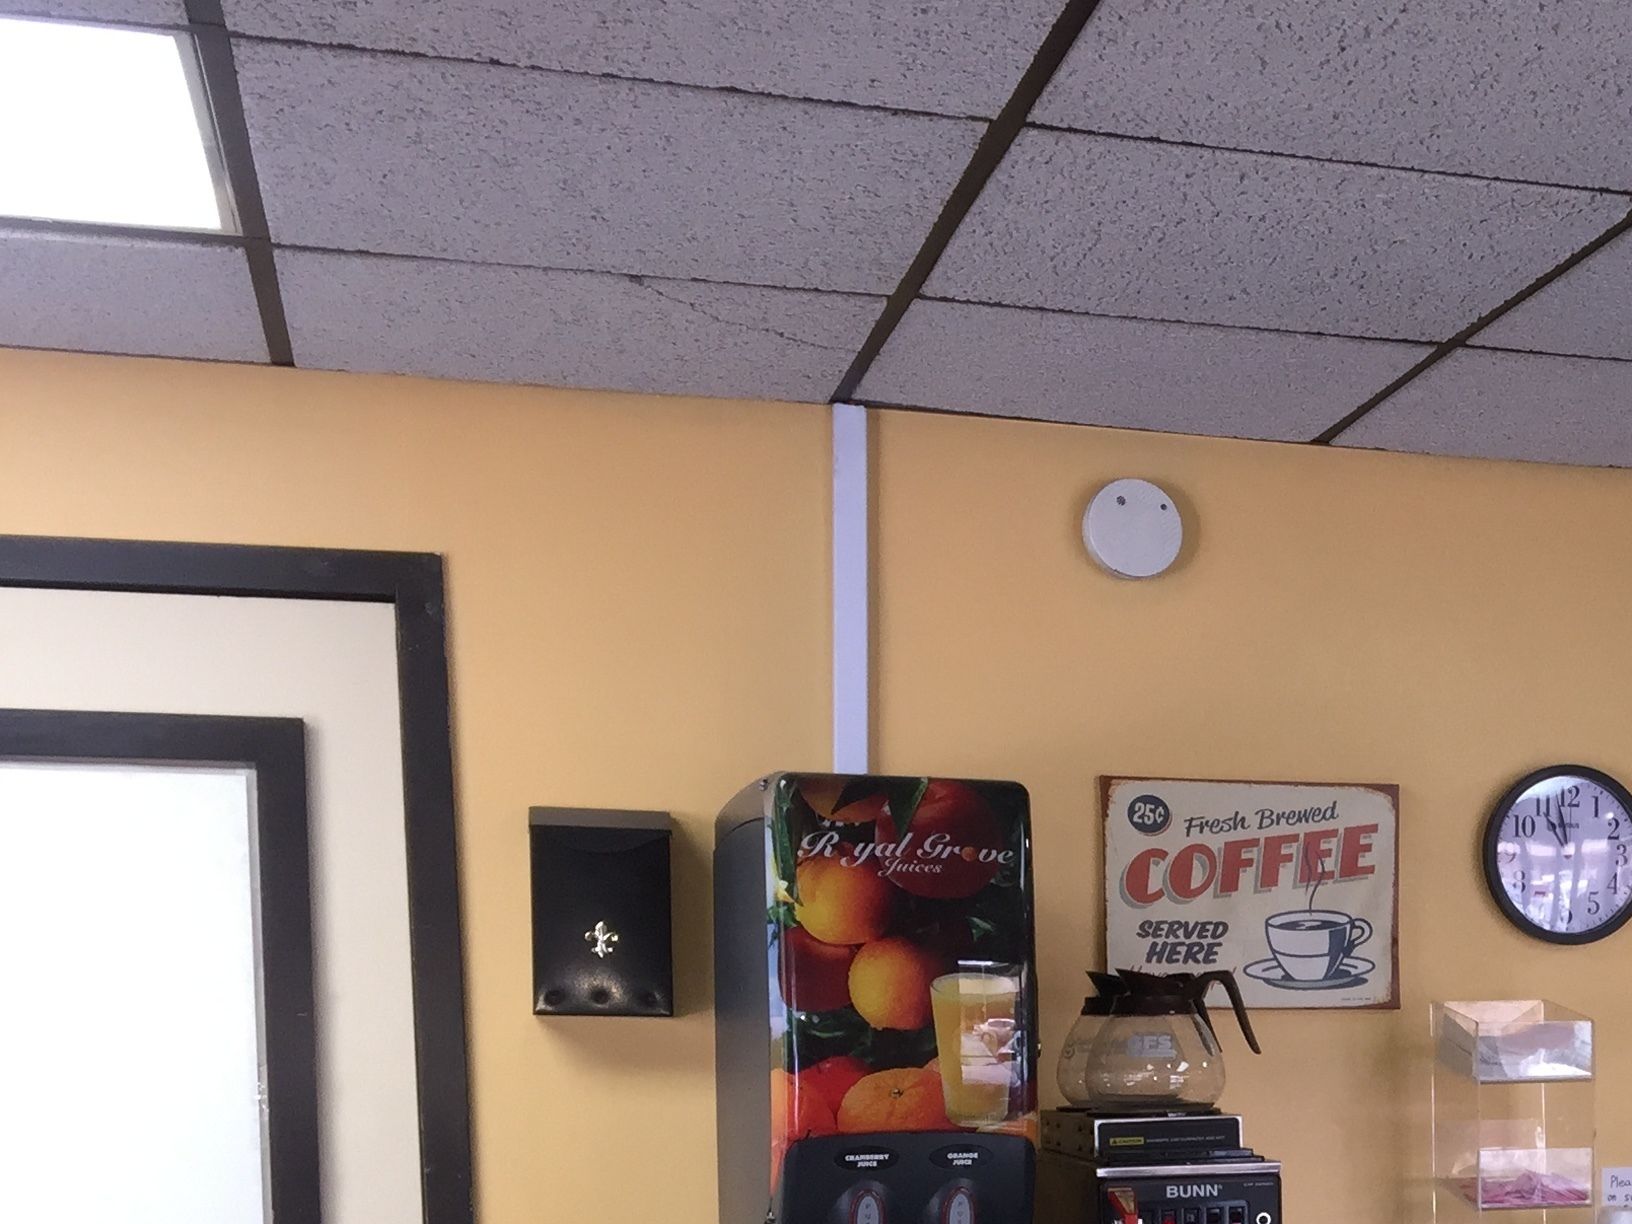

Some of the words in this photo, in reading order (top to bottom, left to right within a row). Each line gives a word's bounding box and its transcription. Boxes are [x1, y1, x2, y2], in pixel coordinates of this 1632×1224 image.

[1559, 785, 1581, 808] 12
[1591, 795, 1600, 819] 1
[1132, 802, 1166, 825] 25¢
[1184, 810, 1251, 838] Fresh
[1255, 800, 1339, 830] Brewed
[1512, 814, 1536, 838] 10
[1607, 818, 1621, 841] 2
[917, 832, 1014, 865] Grove
[1615, 843, 1628, 867] 3
[878, 857, 944, 876] Juices
[1122, 823, 1379, 907] COFFEE
[1606, 872, 1618, 895] 4
[1587, 891, 1601, 915] 5
[1136, 920, 1229, 941] SERVED
[1145, 941, 1223, 965] HERE
[845, 1153, 890, 1162] CRANBERRY
[857, 1160, 878, 1168] JUICE
[946, 1152, 979, 1160] ORANGE
[952, 1158, 973, 1166] JUICE
[1166, 1184, 1219, 1198] BUNN
